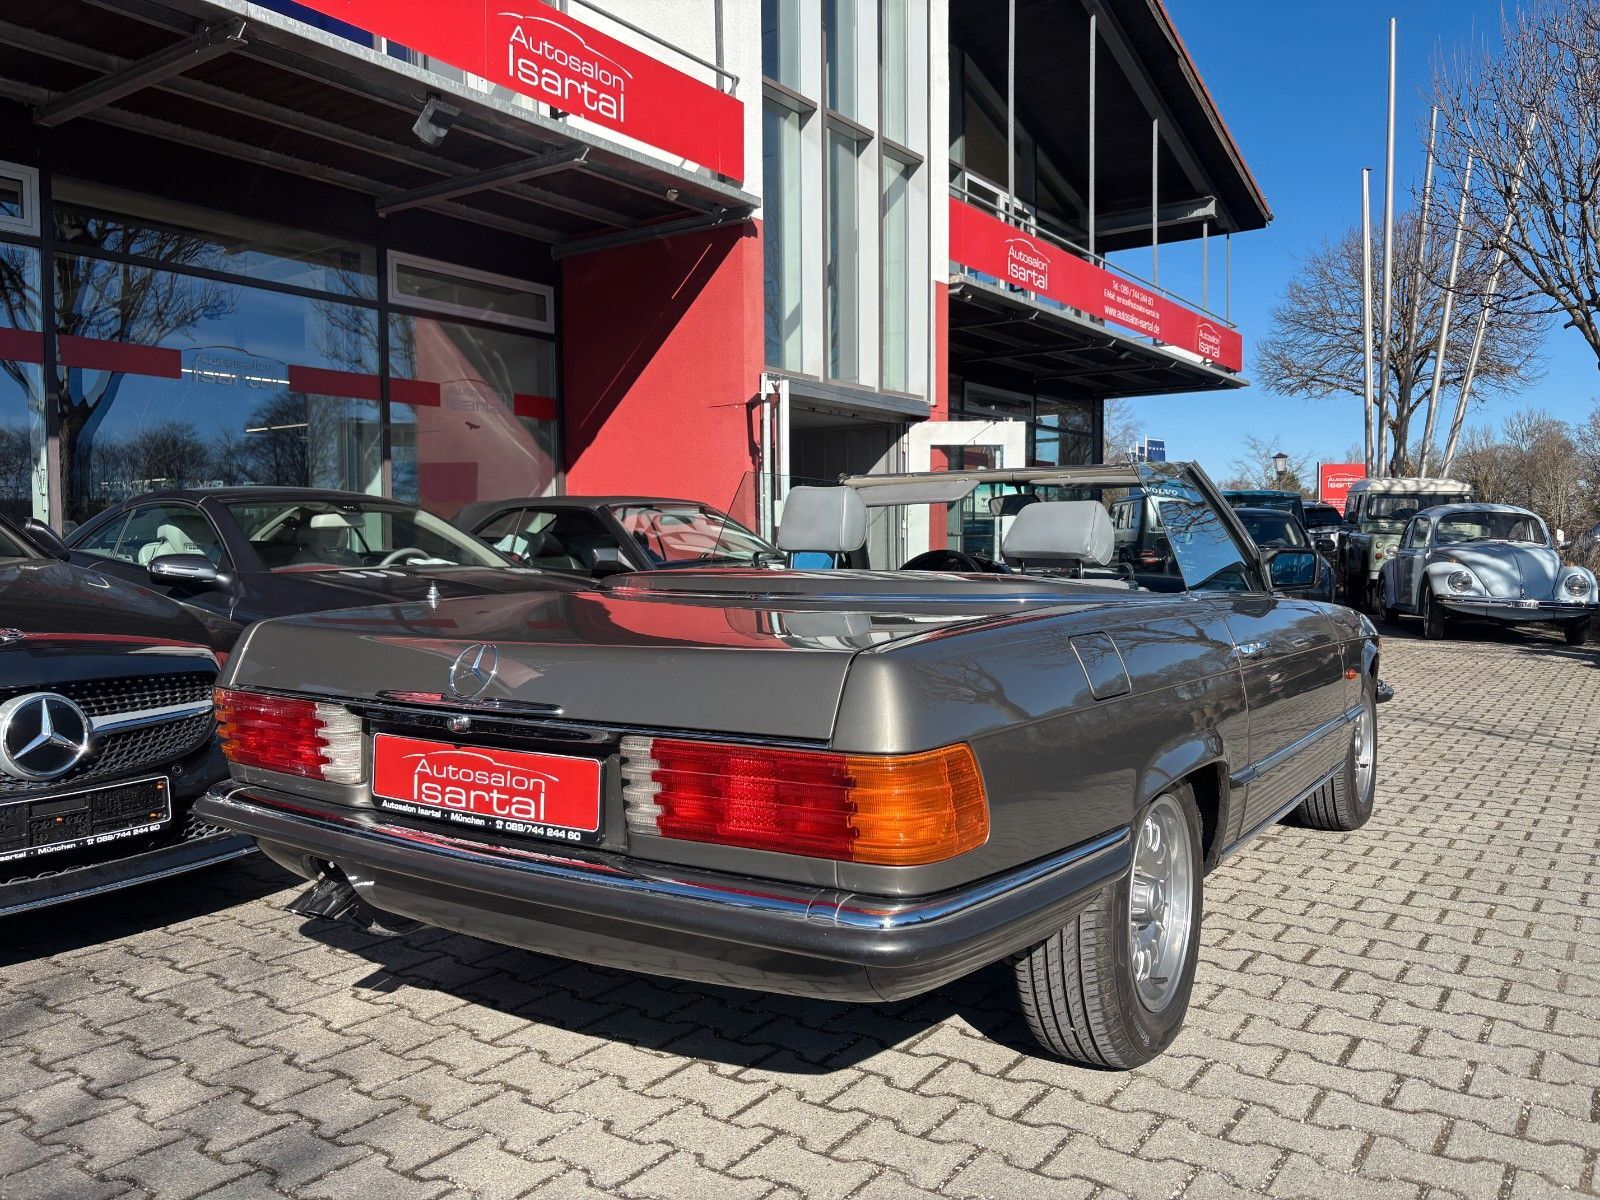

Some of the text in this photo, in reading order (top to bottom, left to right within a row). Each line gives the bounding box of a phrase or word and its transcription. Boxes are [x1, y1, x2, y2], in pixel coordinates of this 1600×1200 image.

[509, 25, 625, 92] Autosalon
[508, 43, 625, 123] Isartal
[1008, 245, 1048, 272] Autosalon
[1008, 256, 1048, 291] Isartal
[1199, 329, 1220, 346] Autosalon
[1199, 335, 1220, 359] Isartal
[1141, 486, 1178, 496] VOLVO
[1327, 481, 1353, 489] Isart
[414, 758, 546, 793] Autosalon
[413, 773, 546, 821] Isartal
[381, 799, 581, 841] Autosalon Isartal München 089/744 244 60
[37, 842, 77, 855] München
[96, 830, 132, 844] 089/744
[133, 826, 149, 837] 244
[149, 823, 161, 833] 60
